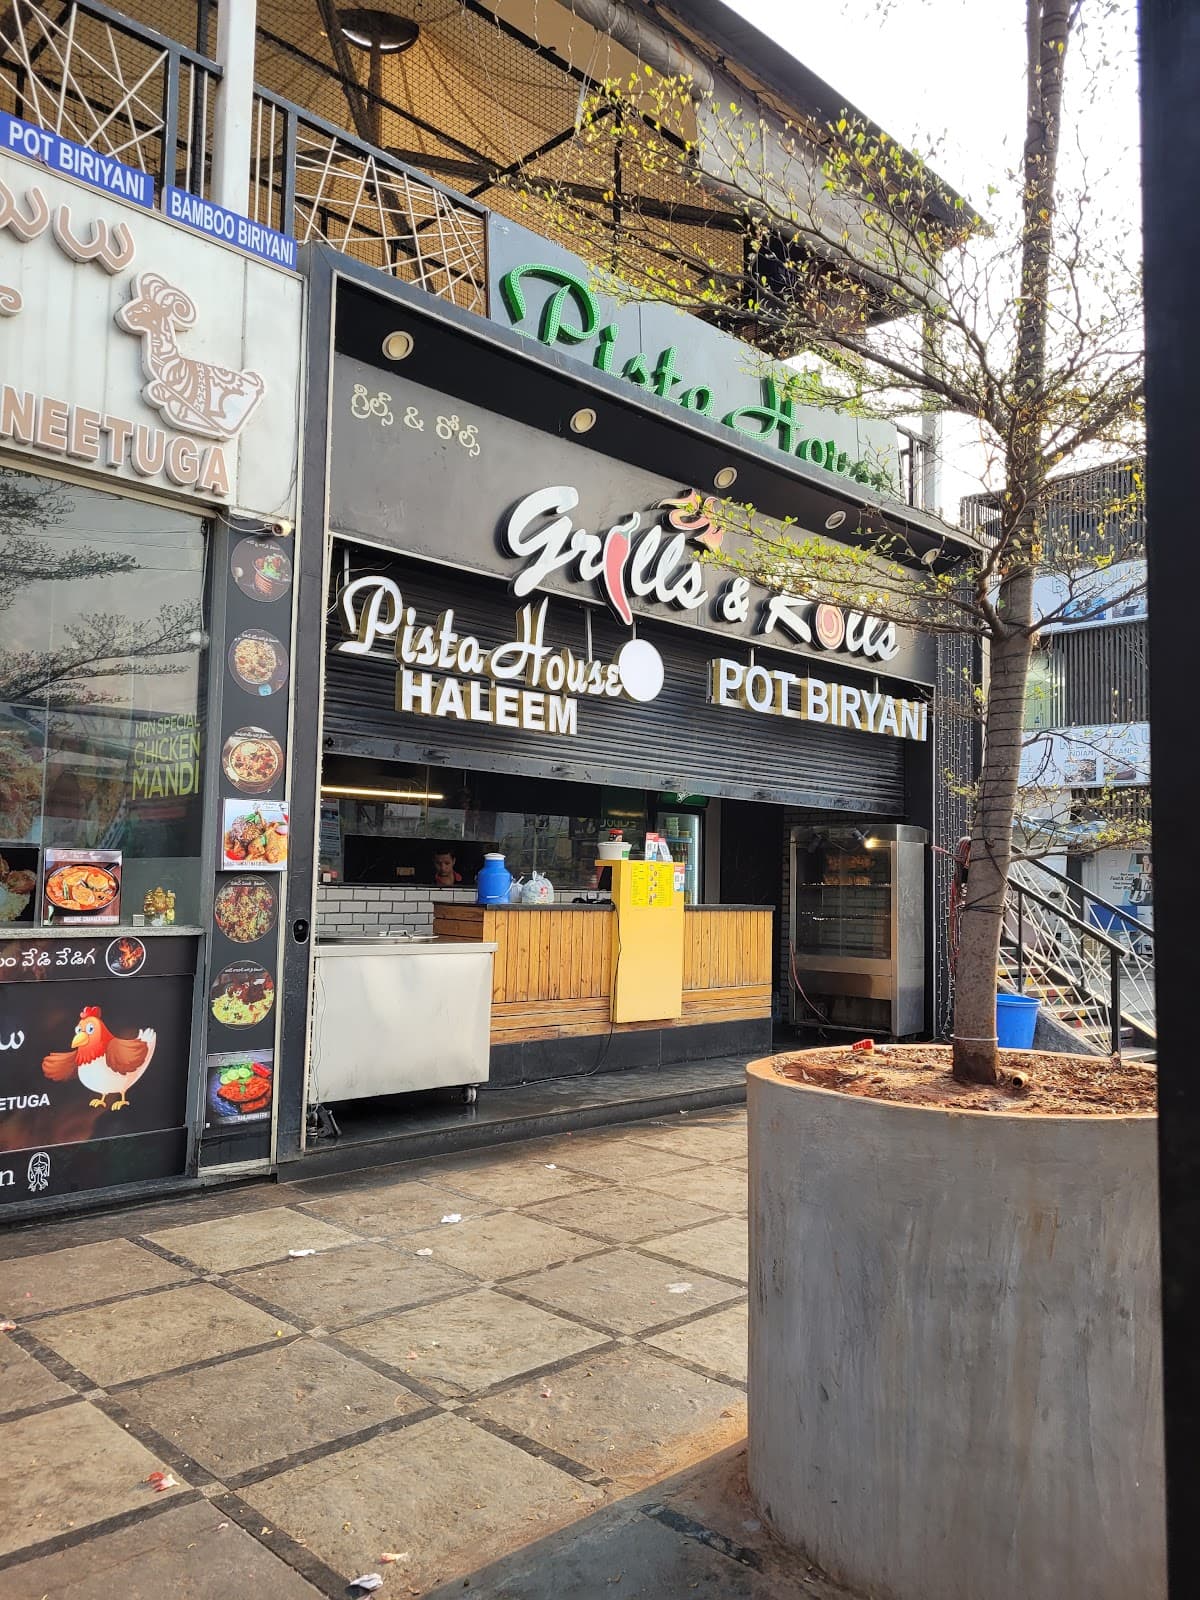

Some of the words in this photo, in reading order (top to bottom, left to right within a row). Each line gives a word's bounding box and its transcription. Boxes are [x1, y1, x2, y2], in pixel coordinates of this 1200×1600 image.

[8, 120, 54, 161] POT
[59, 142, 145, 201] BIRIYANI
[171, 191, 235, 239] BAMBOO
[238, 219, 294, 265] BIRIYANI
[500, 263, 721, 422] Pista
[0, 384, 230, 496] NEETUGA
[403, 406, 425, 432] &
[504, 485, 709, 625] Grills
[719, 576, 750, 623] &
[335, 574, 486, 674] Pista
[487, 596, 624, 697] House
[157, 712, 200, 735] SPECIAL
[397, 669, 578, 735] HALEEM
[711, 657, 799, 718] POT
[805, 676, 928, 742] BIRYANI
[131, 759, 200, 801] MANDI
[134, 731, 200, 766] CHICKEN
